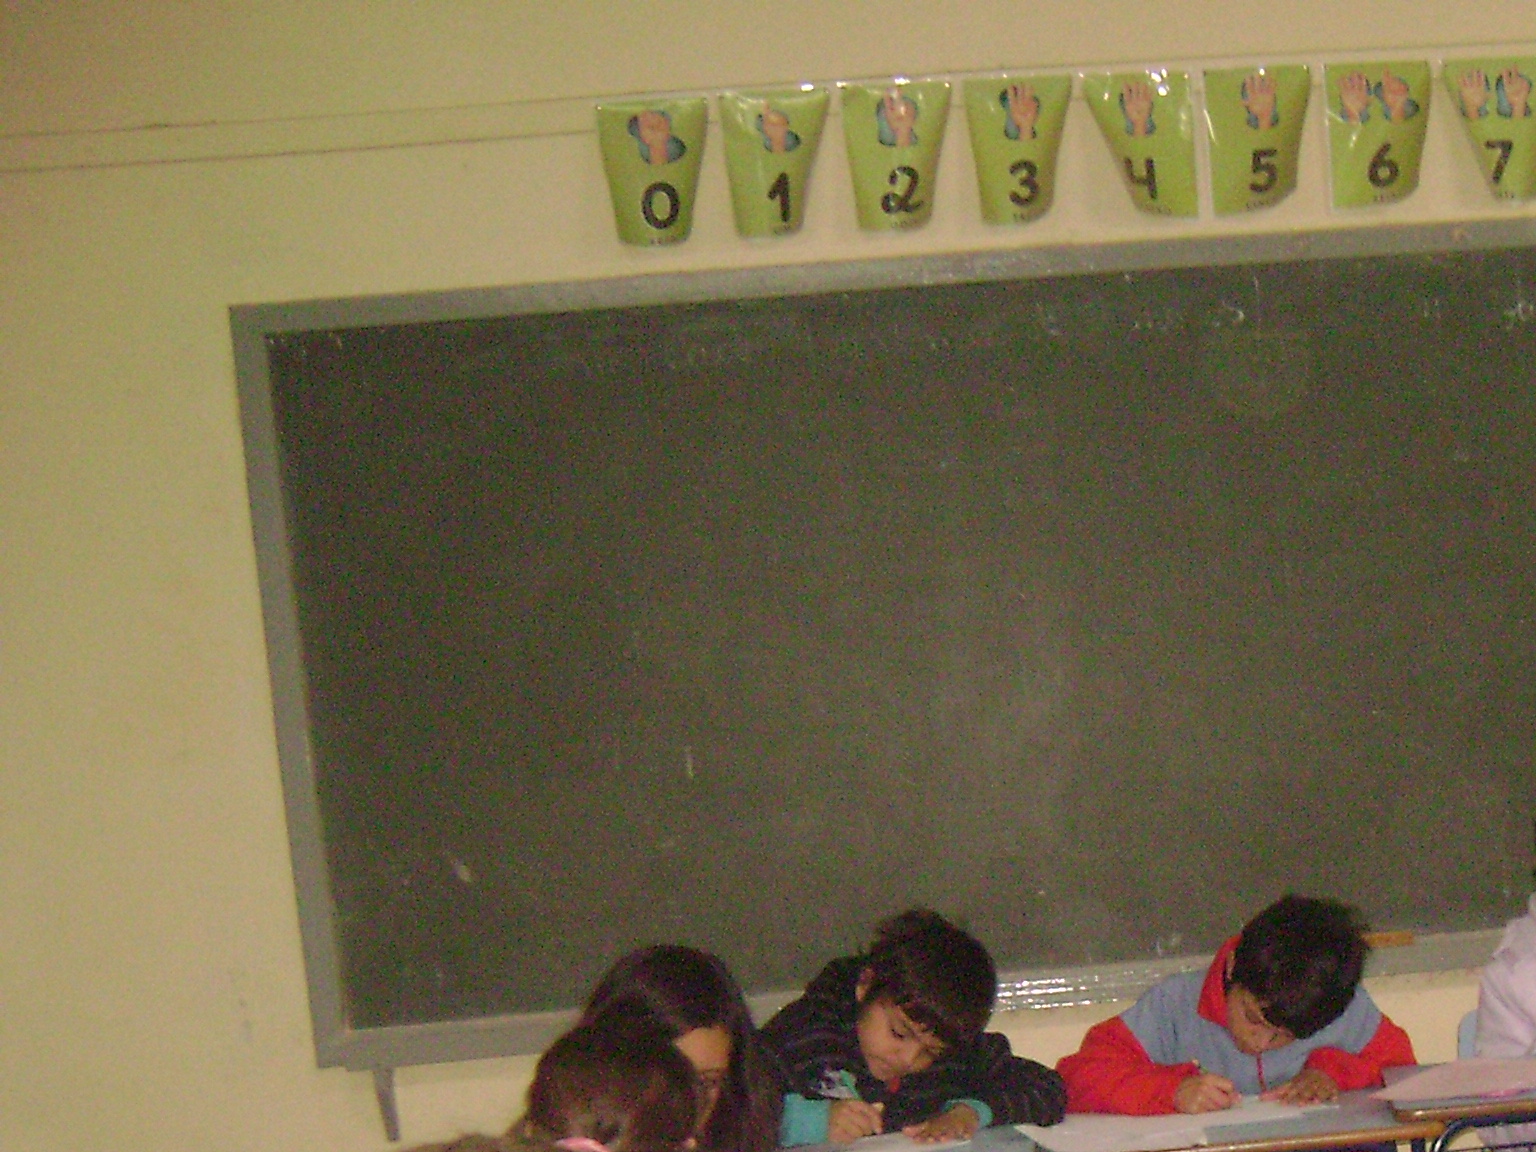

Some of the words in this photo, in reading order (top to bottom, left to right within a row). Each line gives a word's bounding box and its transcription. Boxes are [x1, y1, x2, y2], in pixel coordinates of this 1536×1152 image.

[1008, 160, 1039, 206] 3
[1124, 157, 1157, 200] 4
[1249, 149, 1278, 193] 5
[1368, 143, 1399, 187] 6
[1485, 140, 1512, 184] 7
[641, 181, 681, 229] 0
[768, 172, 790, 223] 1
[880, 166, 921, 213] 2
